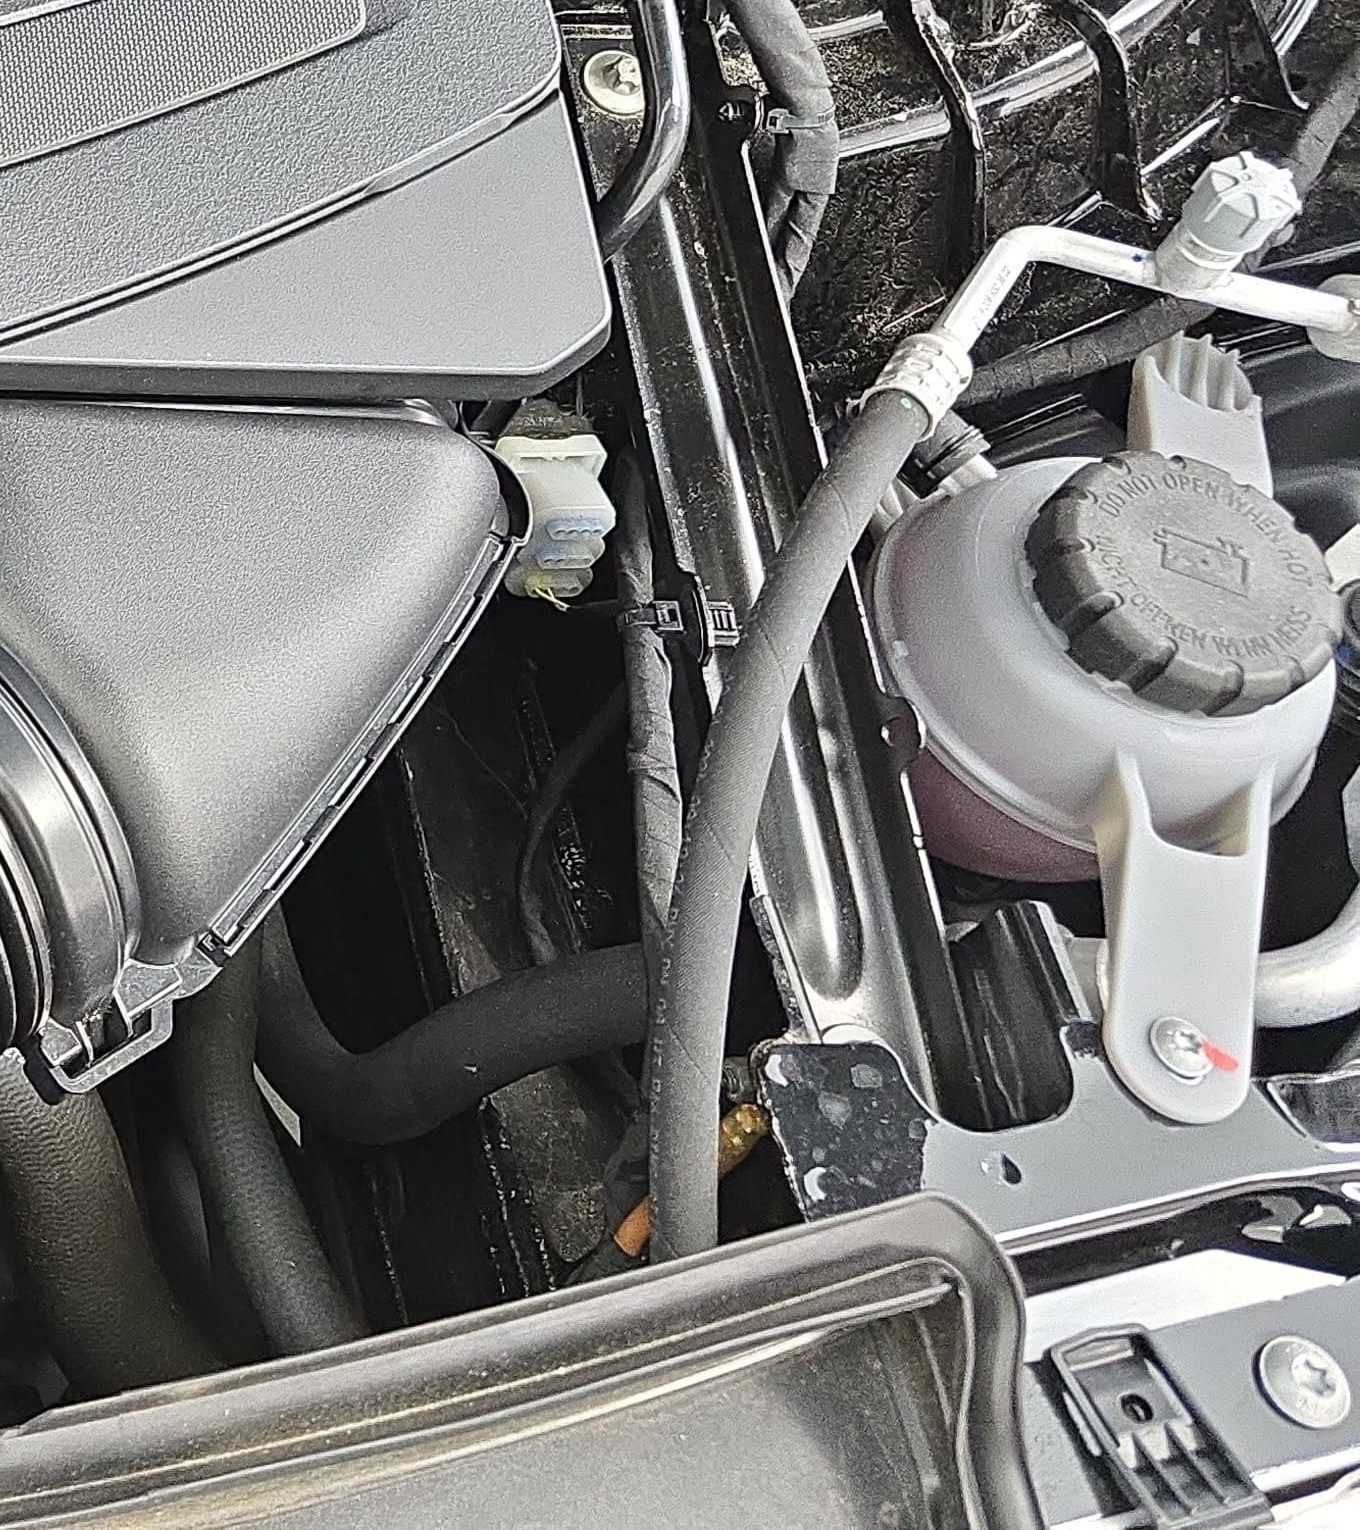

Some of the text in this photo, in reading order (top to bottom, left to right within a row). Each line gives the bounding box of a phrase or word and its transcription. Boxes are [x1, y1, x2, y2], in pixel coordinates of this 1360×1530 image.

[1099, 492, 1127, 518] DO
[1118, 474, 1158, 499] NOT
[1162, 472, 1219, 501] OPEN
[1226, 488, 1283, 543] WHEN
